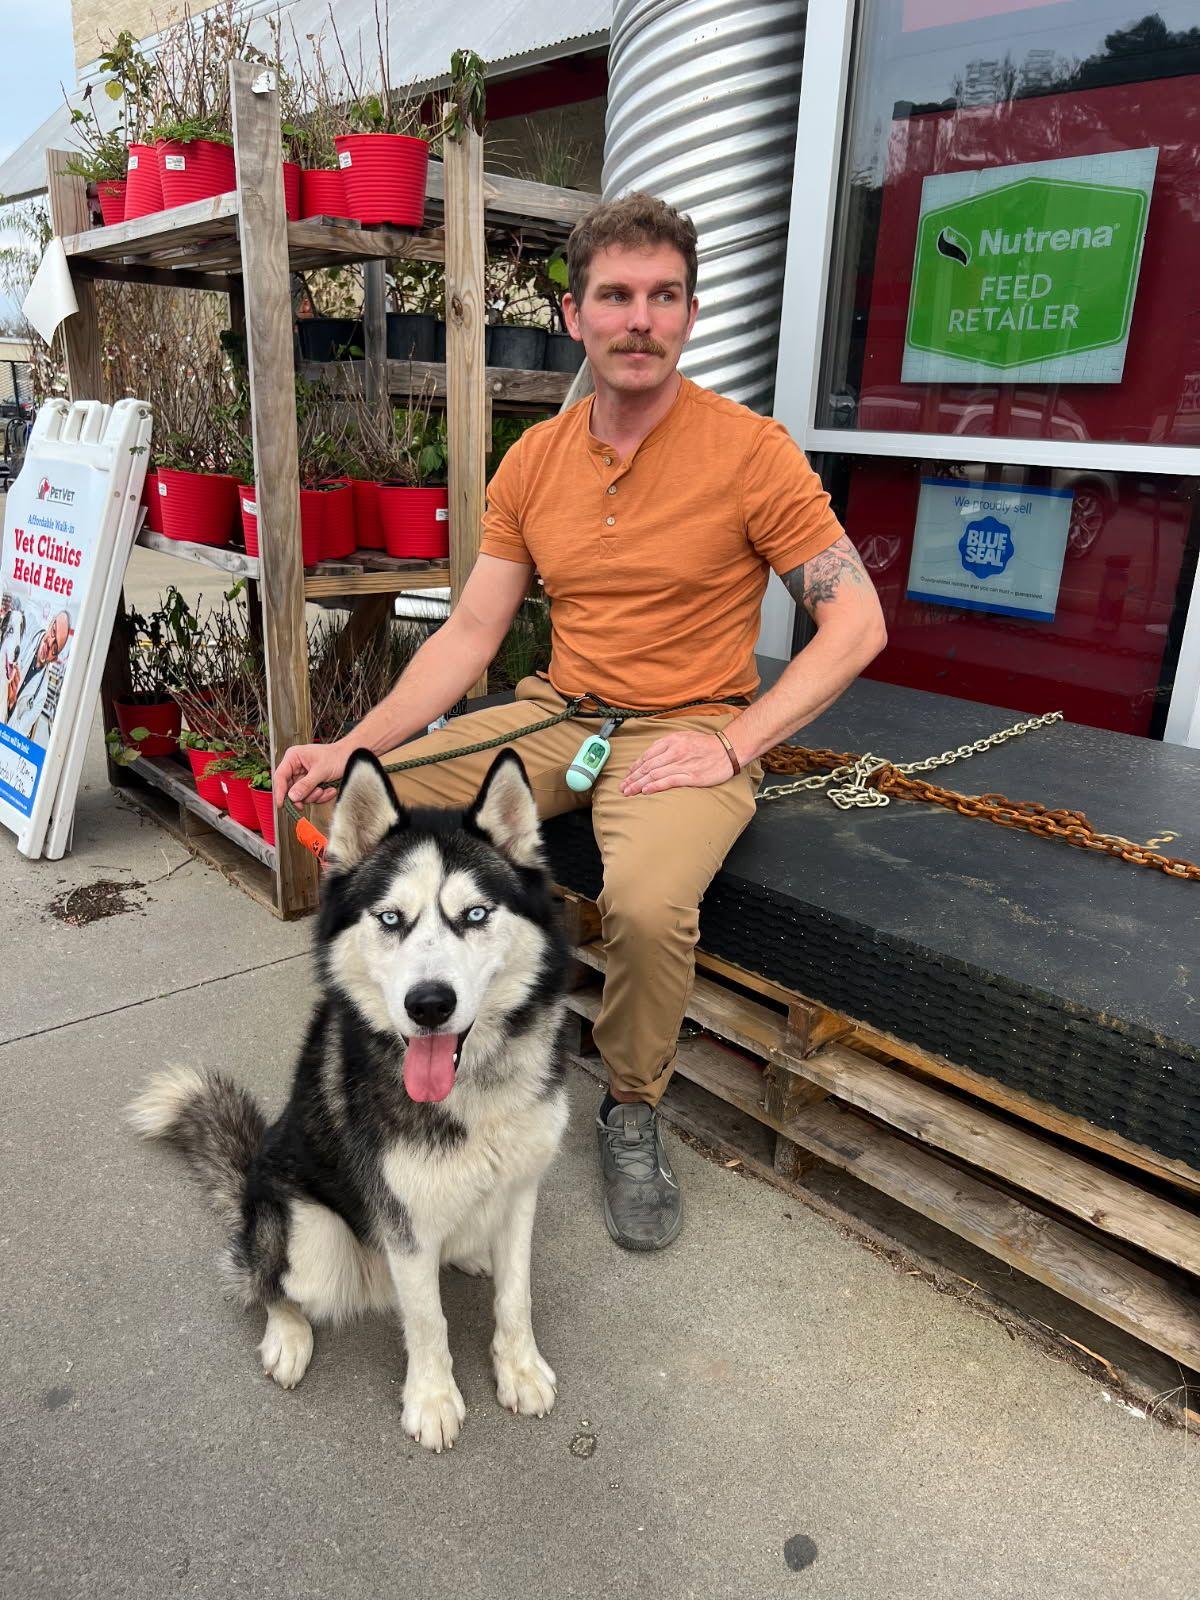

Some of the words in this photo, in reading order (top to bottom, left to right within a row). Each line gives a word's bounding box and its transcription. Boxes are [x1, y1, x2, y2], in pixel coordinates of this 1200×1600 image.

[980, 273, 1052, 301] FEED
[948, 303, 1080, 333] RETAILER
[954, 495, 970, 507] We
[973, 498, 1011, 515] proudly
[1013, 502, 1032, 515] sell
[14, 528, 34, 554] Vet
[37, 534, 82, 568] Clinics
[966, 529, 1008, 550] BLUE
[965, 546, 1004, 567] SEAL
[13, 557, 42, 586] Held
[44, 566, 74, 597] Here
